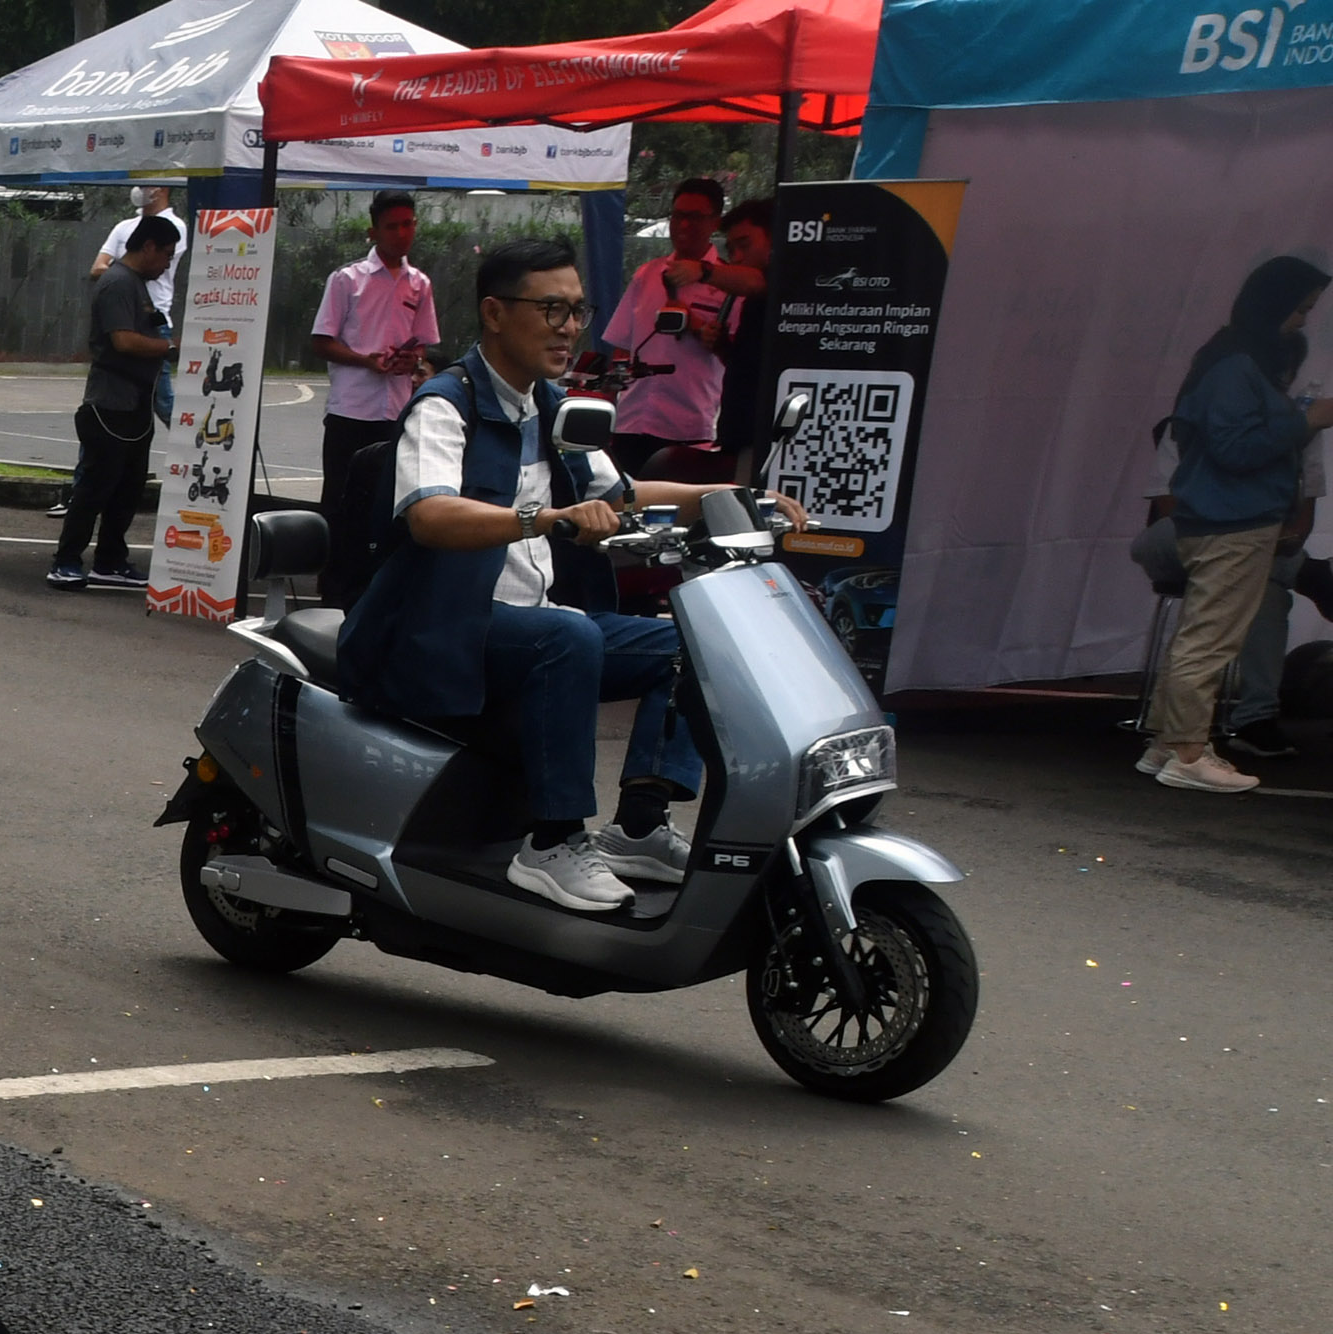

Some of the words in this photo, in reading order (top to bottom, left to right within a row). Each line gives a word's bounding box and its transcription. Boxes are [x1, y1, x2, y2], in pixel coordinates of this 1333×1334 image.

[315, 31, 354, 42] KOTA
[356, 33, 405, 43] BOGOR
[1179, 7, 1284, 74] BSI
[41, 60, 157, 96] bank
[139, 50, 230, 97] bjb
[393, 76, 430, 101] THE
[429, 71, 498, 98] LEADER
[505, 63, 526, 91] OF
[533, 48, 689, 88] ELECTROMOBILE
[788, 221, 823, 242] BSI
[224, 264, 261, 280] Motor
[220, 286, 259, 306] Listrik
[780, 303, 815, 317] Miliki
[815, 303, 883, 317] Kendaraan
[885, 304, 931, 318] Impian
[778, 320, 820, 335] dengan
[821, 320, 881, 336] Angsuran
[883, 321, 929, 337] Ringan
[819, 337, 877, 353] Sekarang
[186, 360, 202, 374] X7
[180, 412, 195, 426] P6
[714, 853, 750, 868] P6
